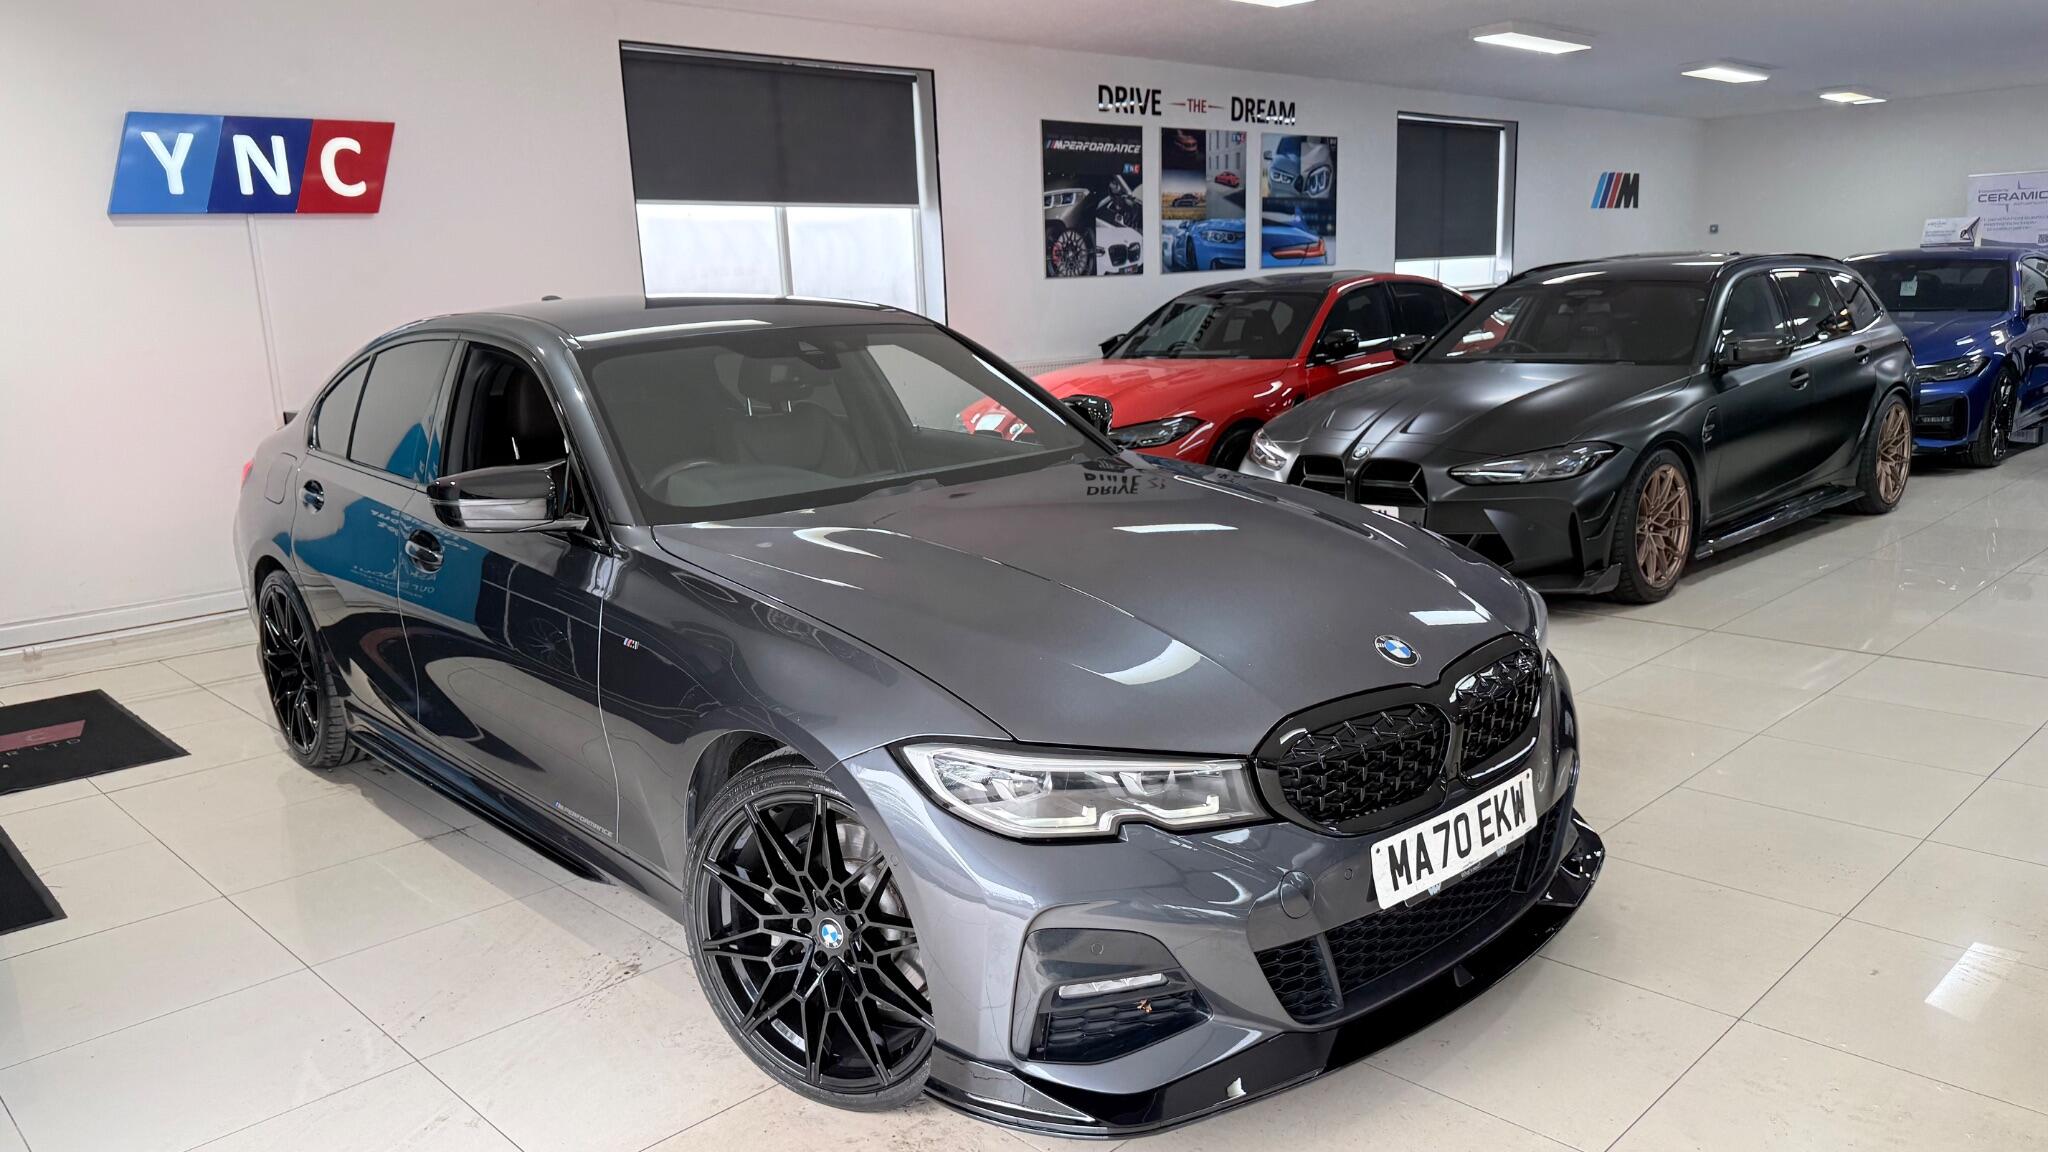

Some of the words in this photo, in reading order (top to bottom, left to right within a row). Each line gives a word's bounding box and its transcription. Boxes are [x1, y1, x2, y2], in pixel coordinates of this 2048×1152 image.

[1098, 84, 1162, 116] DRIVE
[1187, 98, 1207, 113] THE
[1231, 96, 1296, 126] DREAM
[141, 131, 367, 197] YNC
[1388, 812, 1472, 891] MA70
[1477, 781, 1526, 847] EKW
